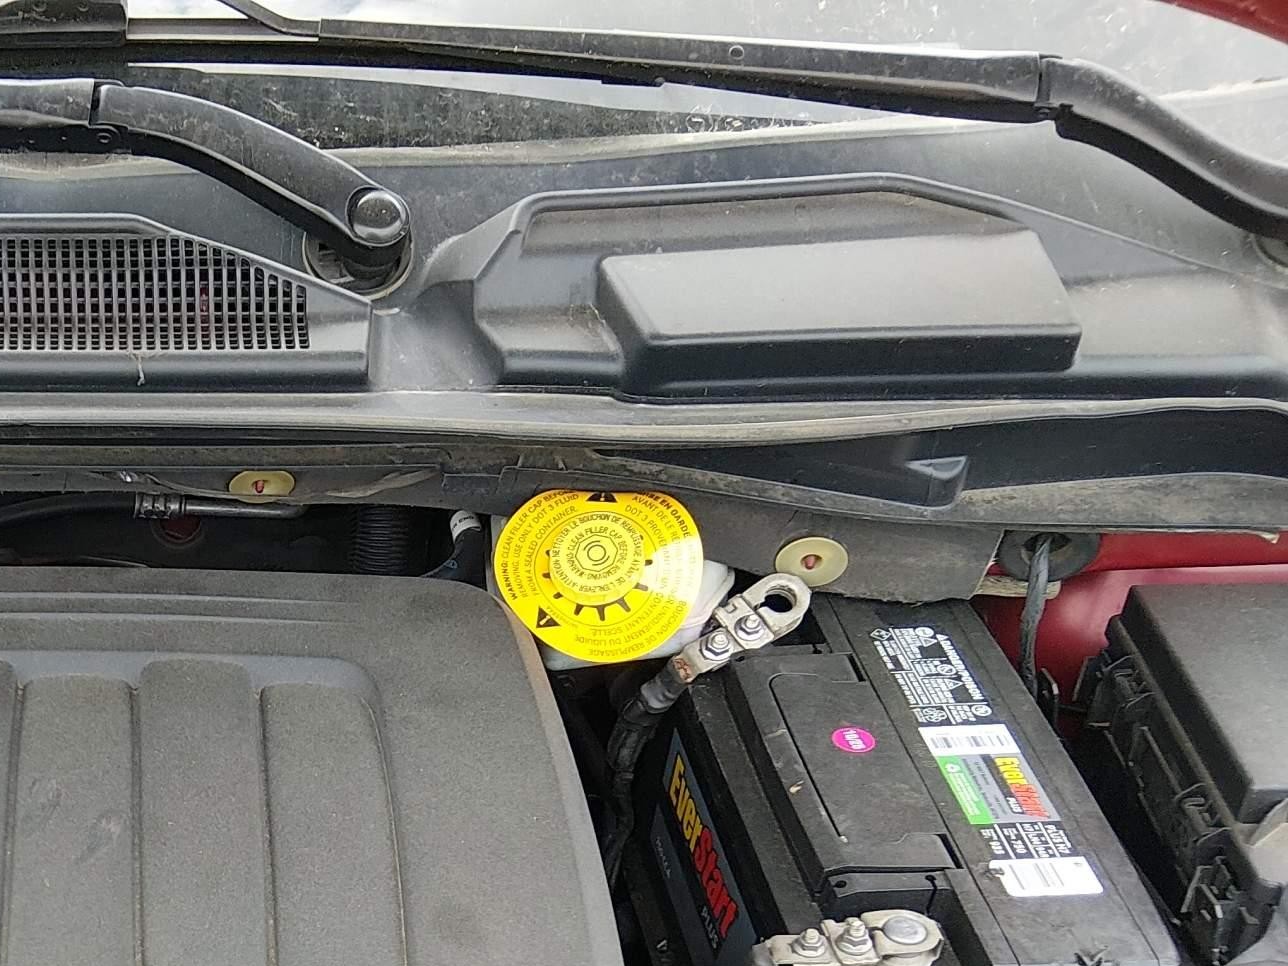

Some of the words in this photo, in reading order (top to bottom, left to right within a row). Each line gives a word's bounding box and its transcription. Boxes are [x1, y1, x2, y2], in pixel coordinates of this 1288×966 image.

[526, 498, 544, 513] CAP
[624, 504, 642, 517] DOT
[631, 493, 659, 512] AVANT
[655, 510, 668, 522] DE
[659, 498, 673, 510] EN
[508, 511, 530, 535] FILLER
[517, 522, 534, 542] ONLY
[531, 507, 549, 524] DOT
[546, 503, 555, 511] 3
[553, 493, 579, 507] FLUID
[502, 535, 514, 558] CLEAN
[526, 539, 538, 568] SEALED
[501, 559, 518, 600] WARNING:
[526, 574, 539, 596] FROM
[655, 599, 688, 637] BOUCHON
[644, 633, 657, 645] DE
[994, 757, 1050, 820] EverStart
[1005, 797, 1023, 814] PLUS
[667, 753, 740, 933] EverStart
[1043, 824, 1065, 842] PLUS
[700, 906, 722, 951] PLUS
